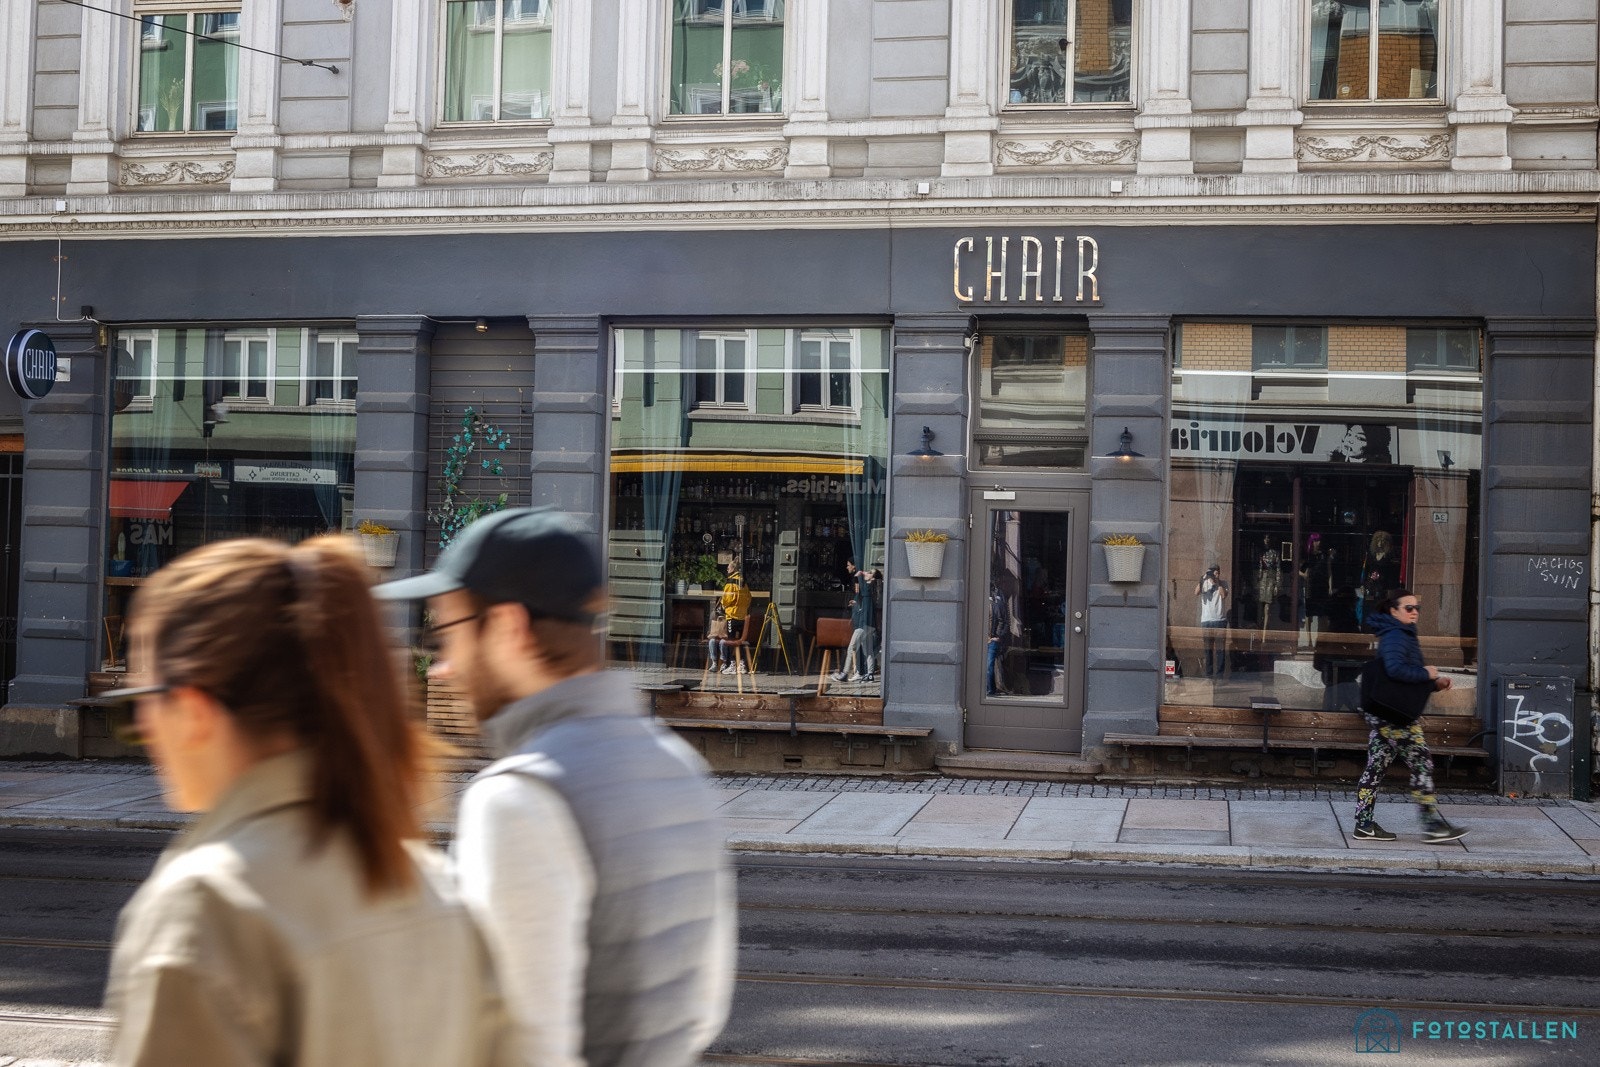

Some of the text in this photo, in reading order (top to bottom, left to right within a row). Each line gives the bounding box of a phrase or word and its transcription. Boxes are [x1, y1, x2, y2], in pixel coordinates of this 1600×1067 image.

[953, 236, 1100, 302] CHAIR
[25, 348, 55, 381] CHAIR
[1527, 557, 1584, 575] NACHOS
[1540, 569, 1581, 589] SVIN
